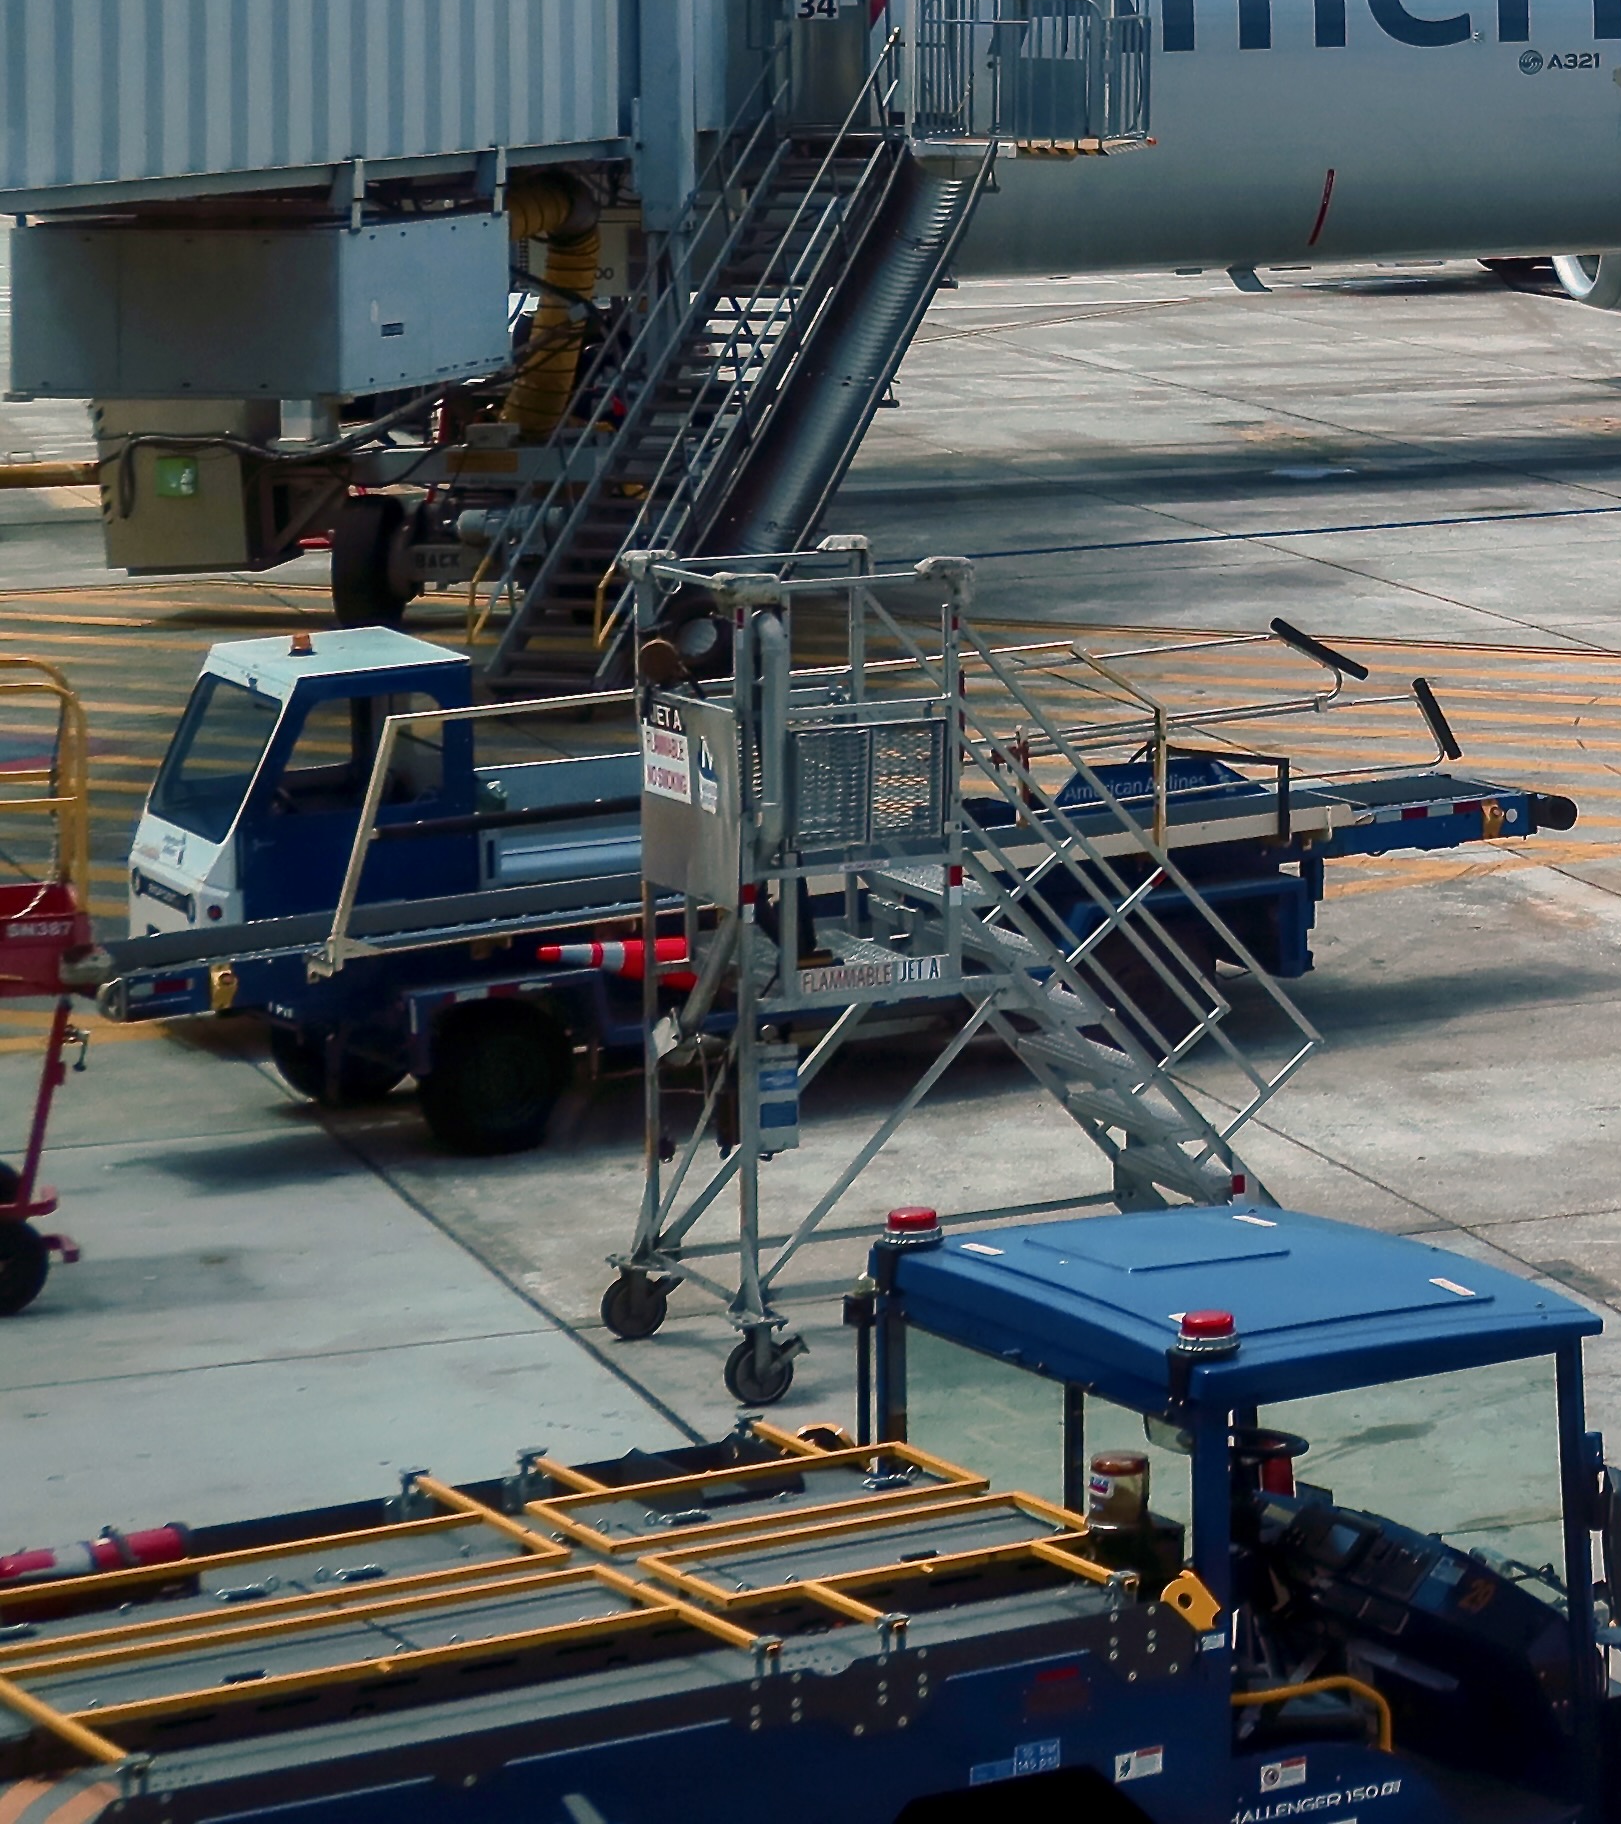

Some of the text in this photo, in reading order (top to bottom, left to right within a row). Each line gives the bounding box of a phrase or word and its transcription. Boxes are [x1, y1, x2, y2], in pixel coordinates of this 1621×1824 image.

[1546, 52, 1600, 70] A321
[650, 703, 671, 728] JET
[1144, 773, 1208, 794] Alines
[801, 957, 941, 994] FLAMMABLE JET A
[1345, 1785, 1379, 1804] 150
